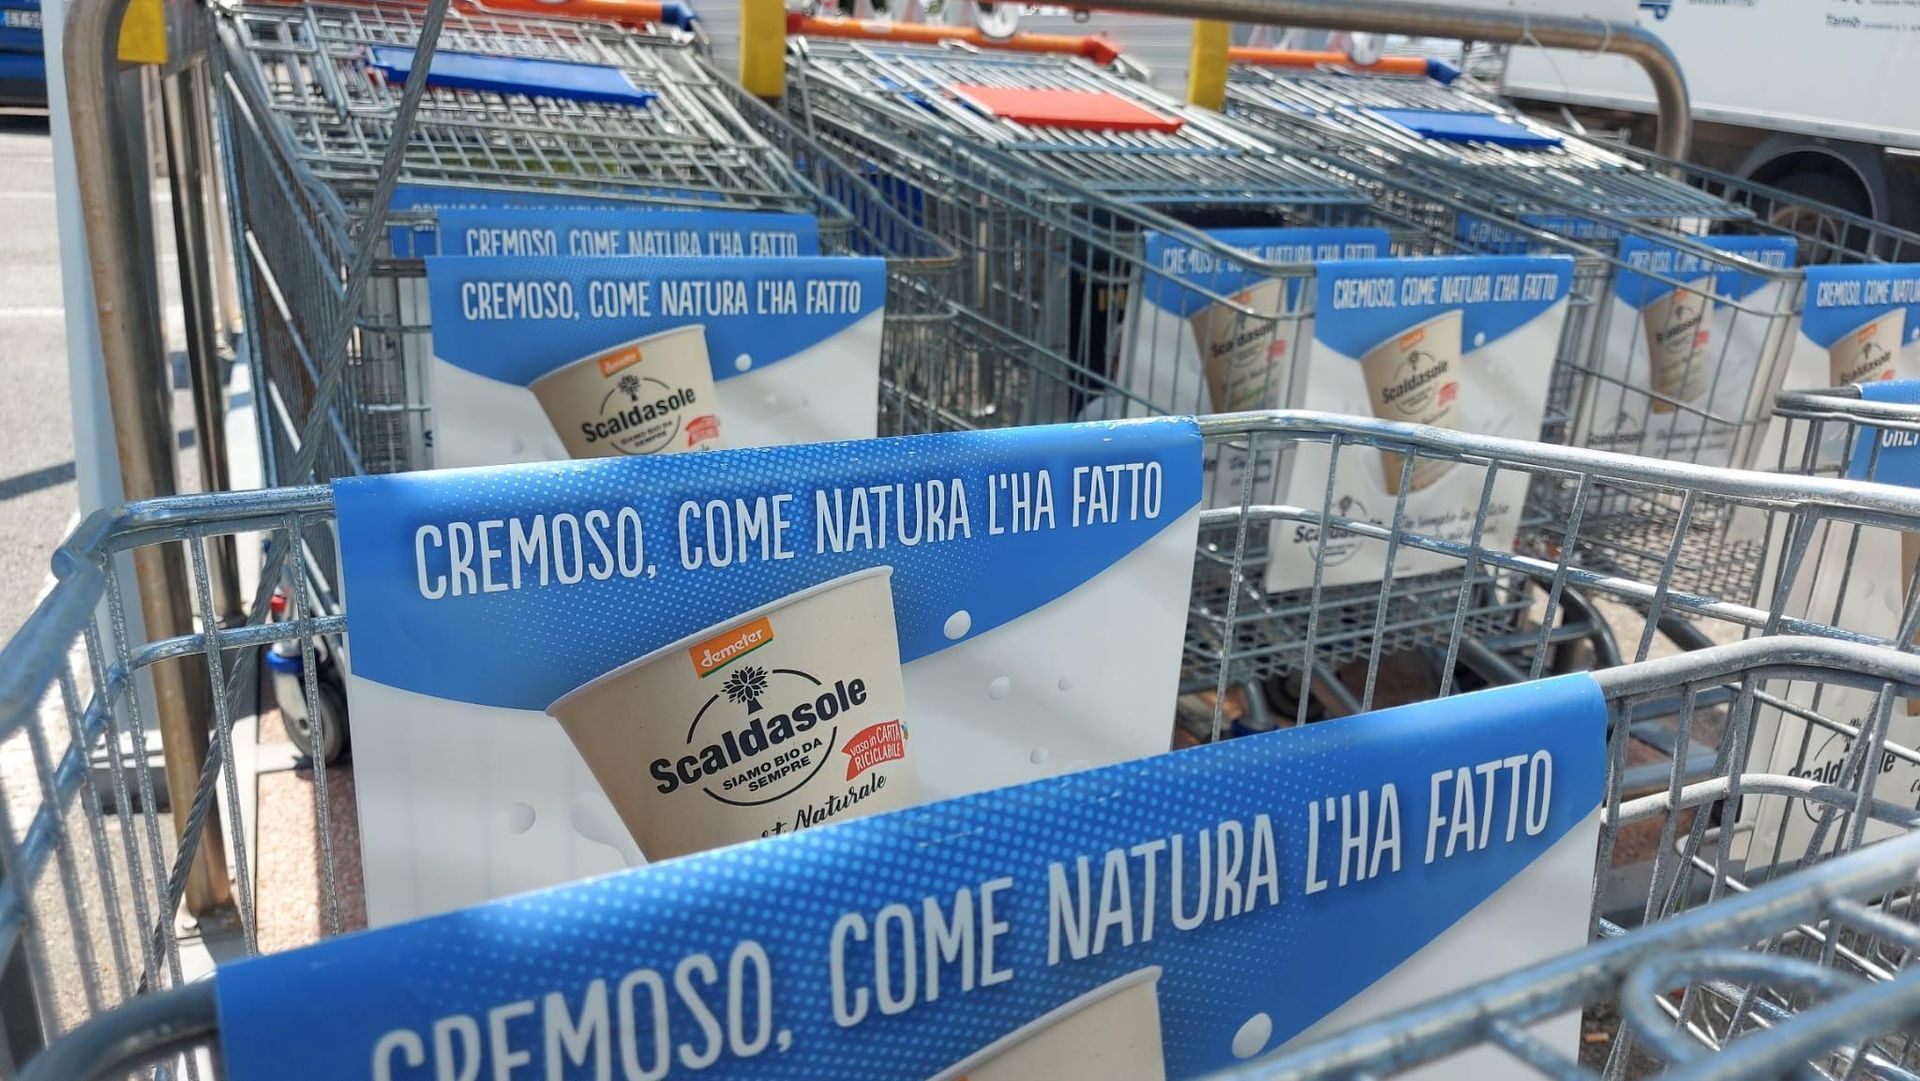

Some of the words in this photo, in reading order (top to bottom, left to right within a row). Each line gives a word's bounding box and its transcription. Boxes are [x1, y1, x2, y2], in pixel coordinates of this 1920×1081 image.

[461, 281, 581, 321] CREMOSO,
[589, 281, 650, 318] COME
[661, 280, 749, 317] NATURA
[757, 279, 797, 315] L'HA
[805, 279, 862, 315] FATTO
[1401, 276, 1439, 307] COME
[1439, 274, 1492, 305] NATURA
[1521, 272, 1558, 301] FATTO
[581, 388, 696, 443] Scaldasole
[414, 506, 657, 600] CREMOSO,
[678, 494, 795, 571] COME
[815, 478, 971, 555] NATURA
[988, 469, 1056, 536] L'HA
[1072, 461, 1163, 528] FATTO
[701, 628, 763, 668] demeter
[648, 677, 868, 795] Scaldasole
[854, 742, 902, 772] RICICLABILE
[876, 723, 901, 743] CARTA
[722, 761, 771, 791] SIAMO
[774, 748, 800, 768] BIO
[802, 737, 823, 754] DA
[748, 755, 811, 793] SEMPRE
[794, 772, 887, 832] Naturale
[828, 876, 1014, 1029] COME
[1047, 813, 1279, 967] NATURA
[1305, 781, 1402, 896] L'HA
[1424, 748, 1553, 865] FATTO
